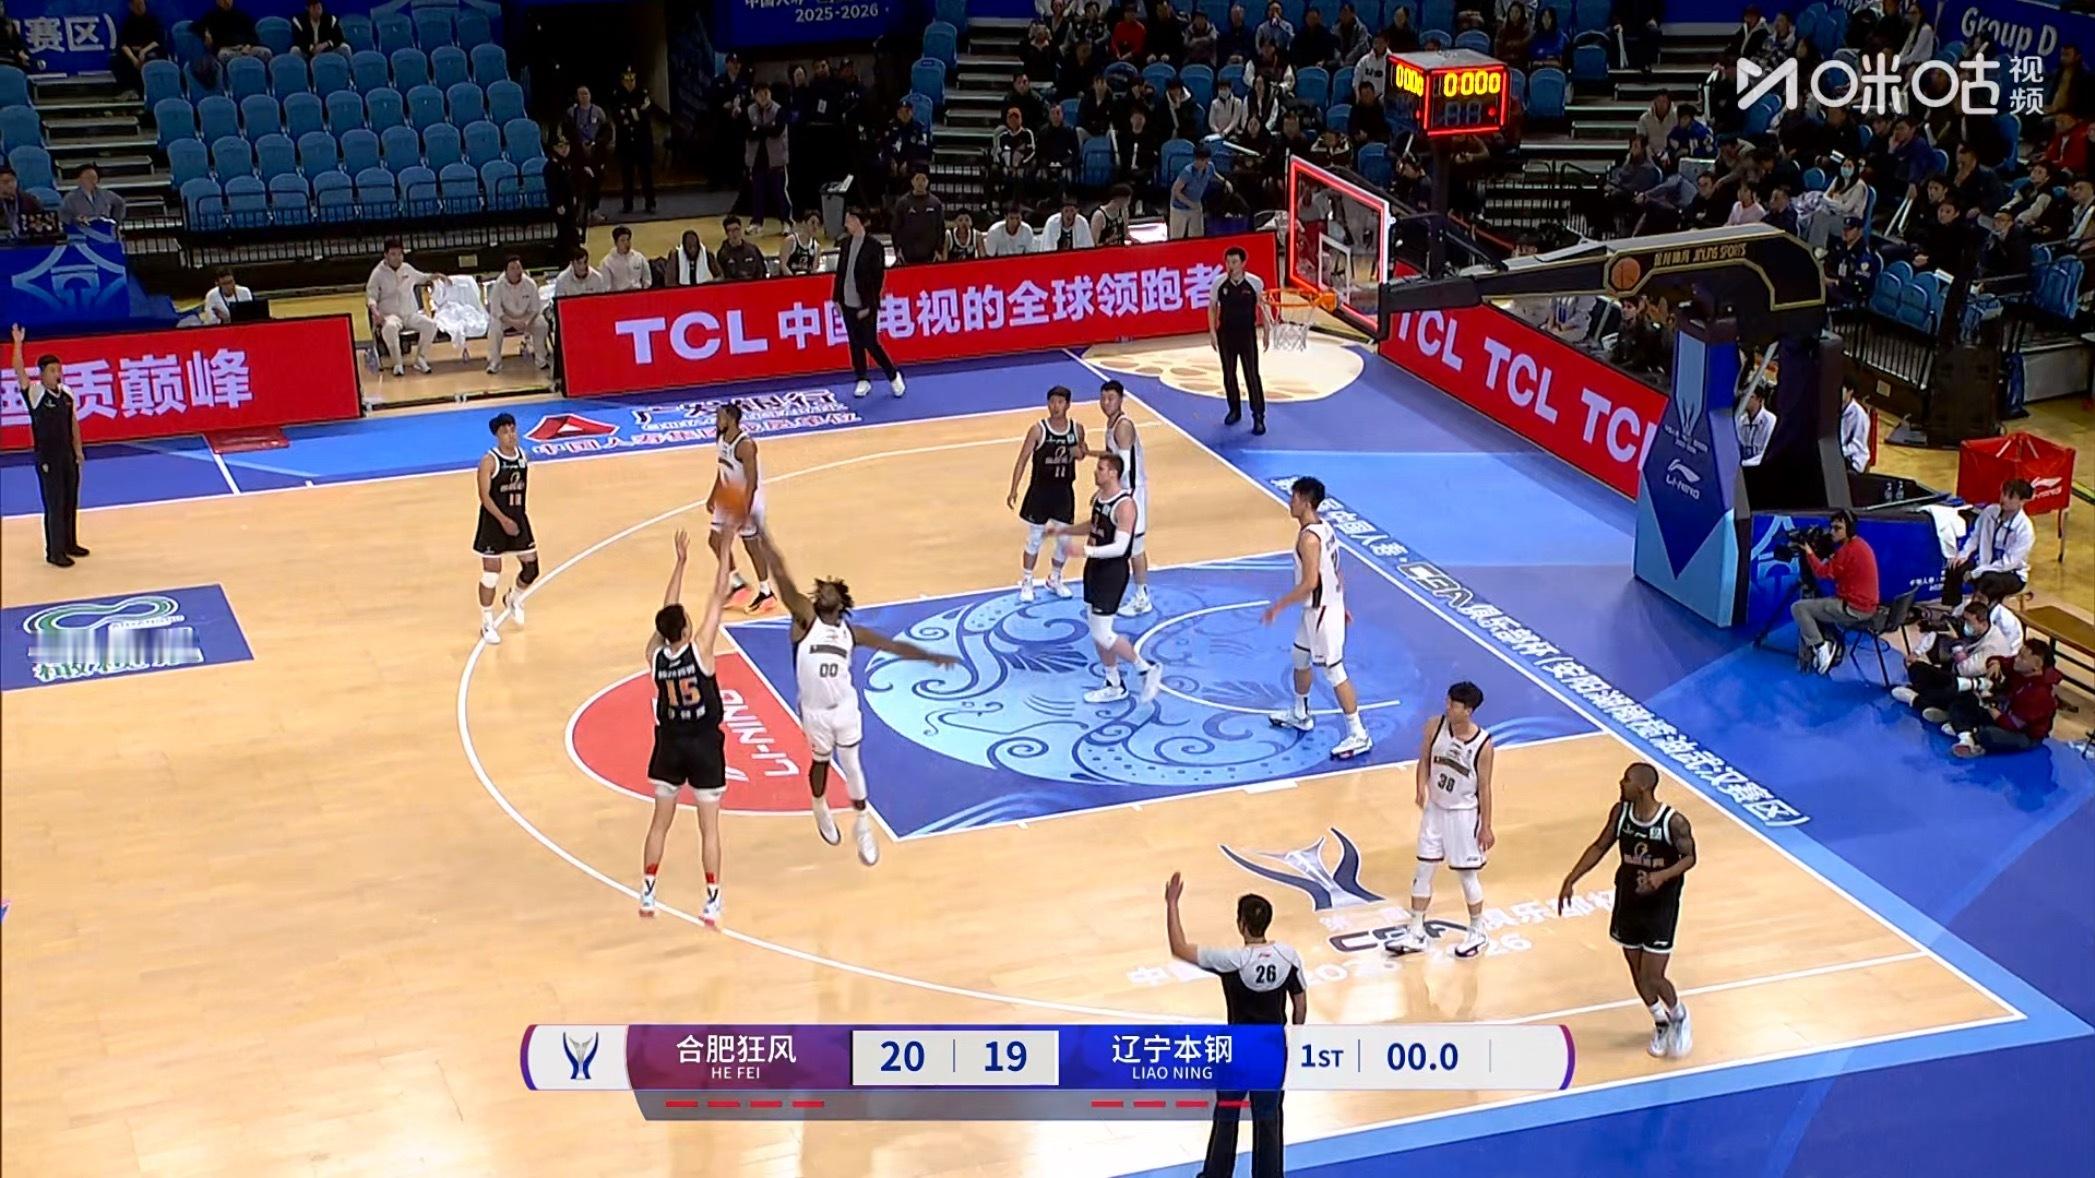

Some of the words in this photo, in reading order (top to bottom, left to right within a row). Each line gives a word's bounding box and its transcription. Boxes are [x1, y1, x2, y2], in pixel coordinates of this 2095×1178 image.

[795, 5, 878, 22] 2025-2026
[13, 13, 117, 54] 赛区)
[2037, 24, 2059, 57] D
[615, 310, 768, 364] TCL
[1483, 336, 1558, 424] TCL
[819, 662, 839, 678] 00
[665, 676, 701, 706] 15
[1255, 964, 1277, 984] 26
